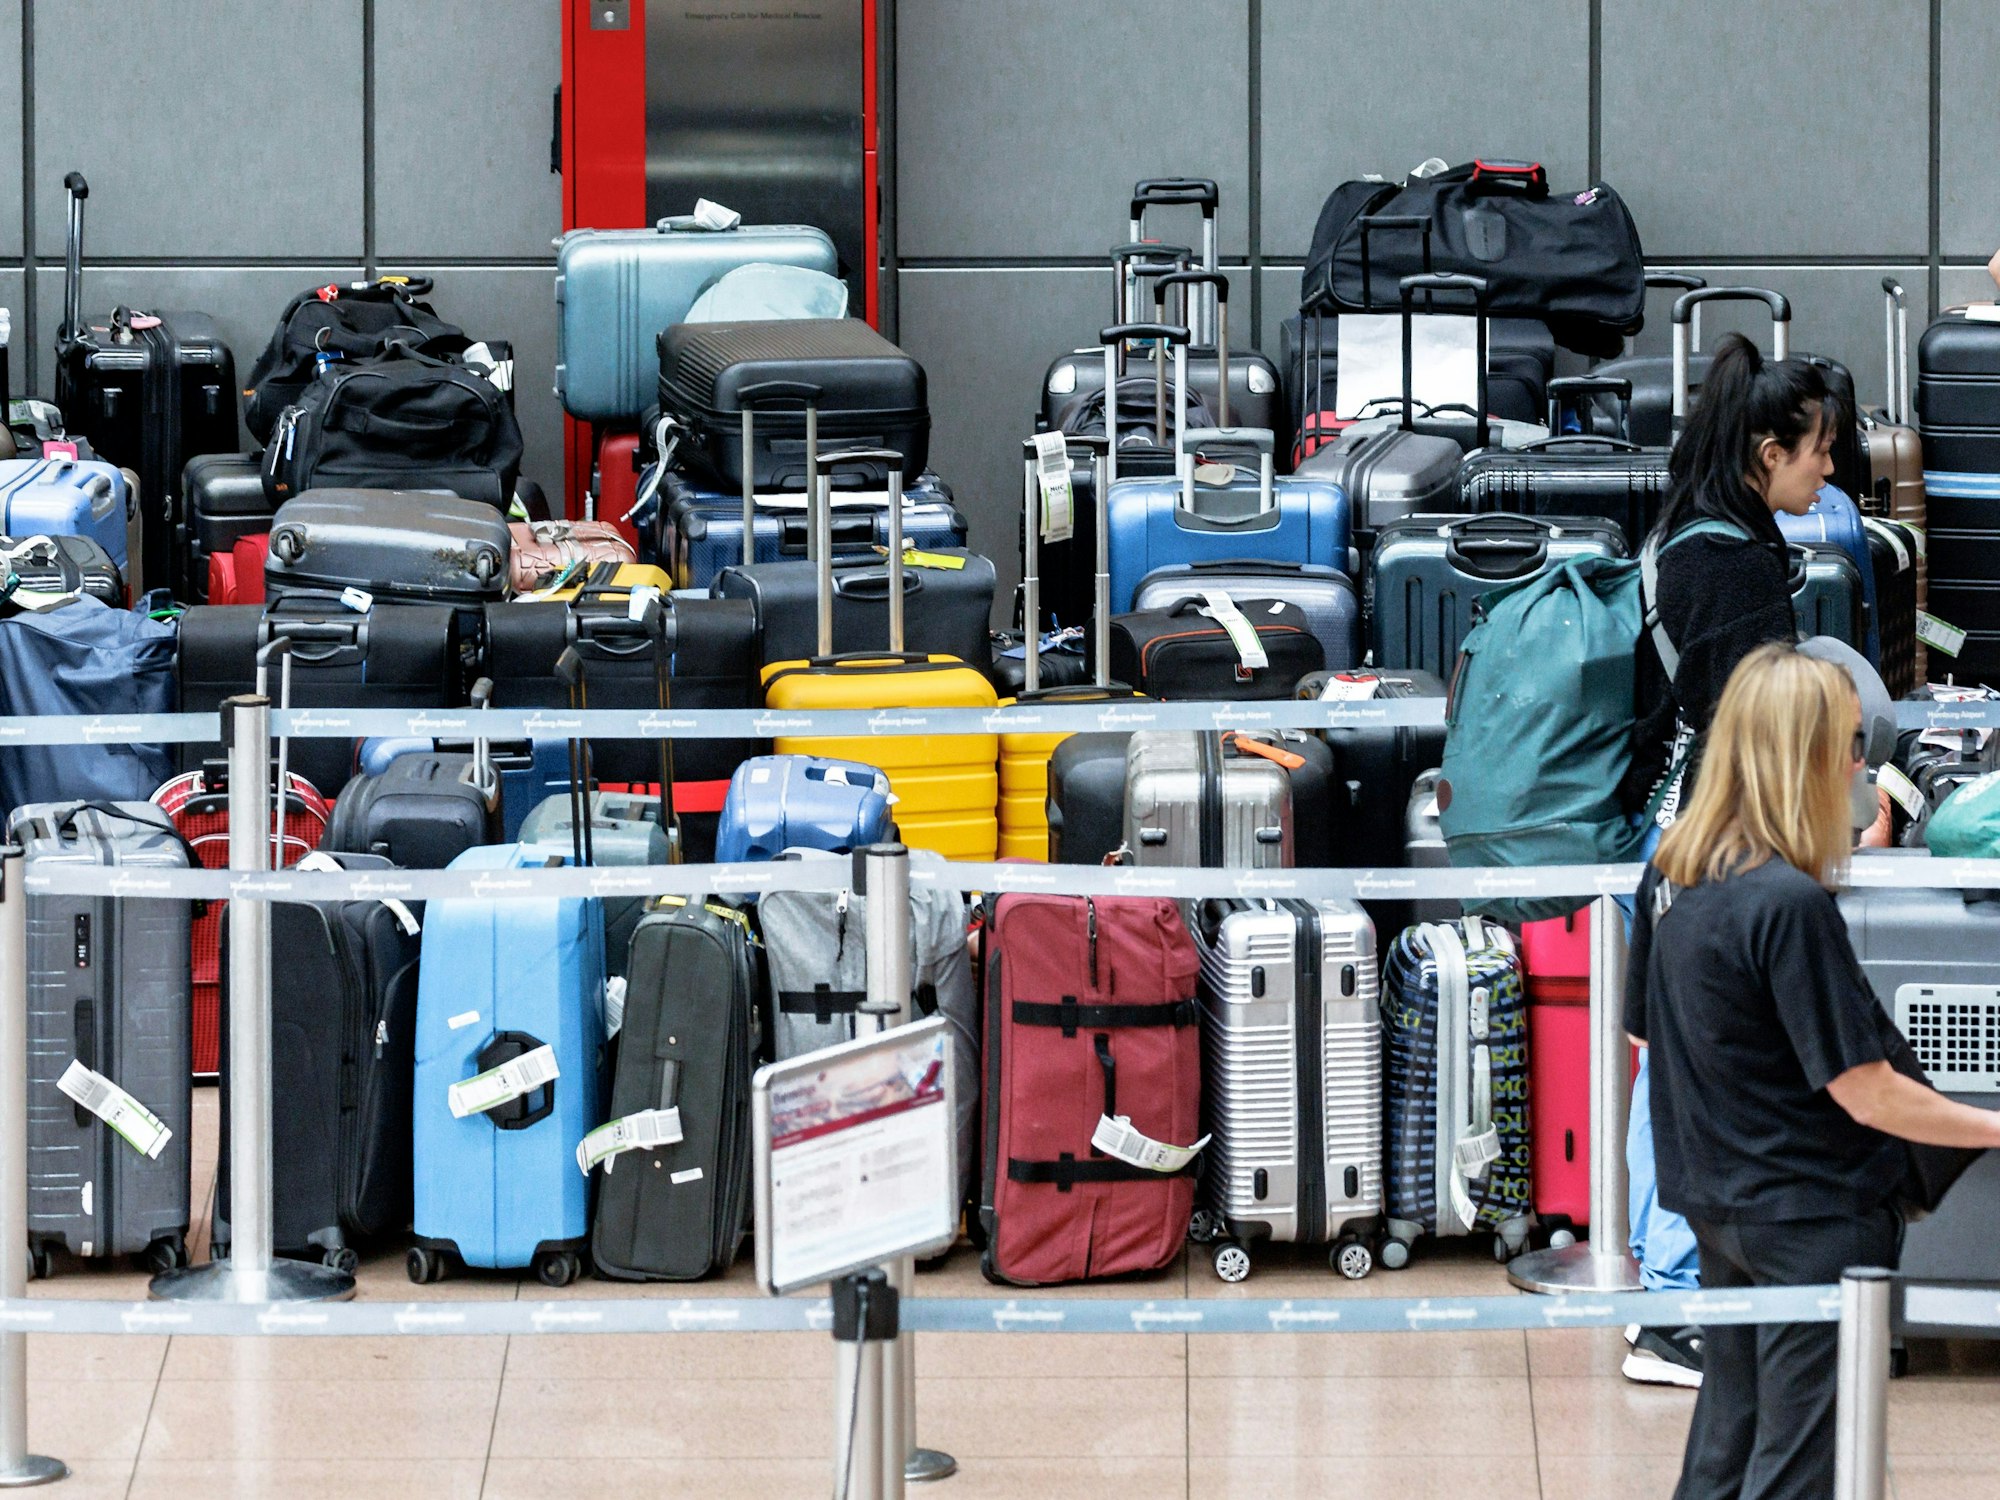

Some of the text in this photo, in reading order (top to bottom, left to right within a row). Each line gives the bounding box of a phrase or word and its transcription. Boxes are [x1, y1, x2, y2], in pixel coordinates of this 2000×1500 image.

[1130, 713, 1156, 722] Airport
[1246, 711, 1271, 720] Airport
[1360, 709, 1386, 718] Airport
[1960, 710, 1986, 718] Airport
[324, 718, 350, 727] Airport
[440, 720, 466, 728] Airport
[556, 720, 582, 728] Airport
[672, 720, 697, 728] Airport
[786, 718, 812, 726] Airport
[902, 717, 927, 726] Airport
[1016, 716, 1041, 724] Airport
[116, 726, 141, 734] Airport
